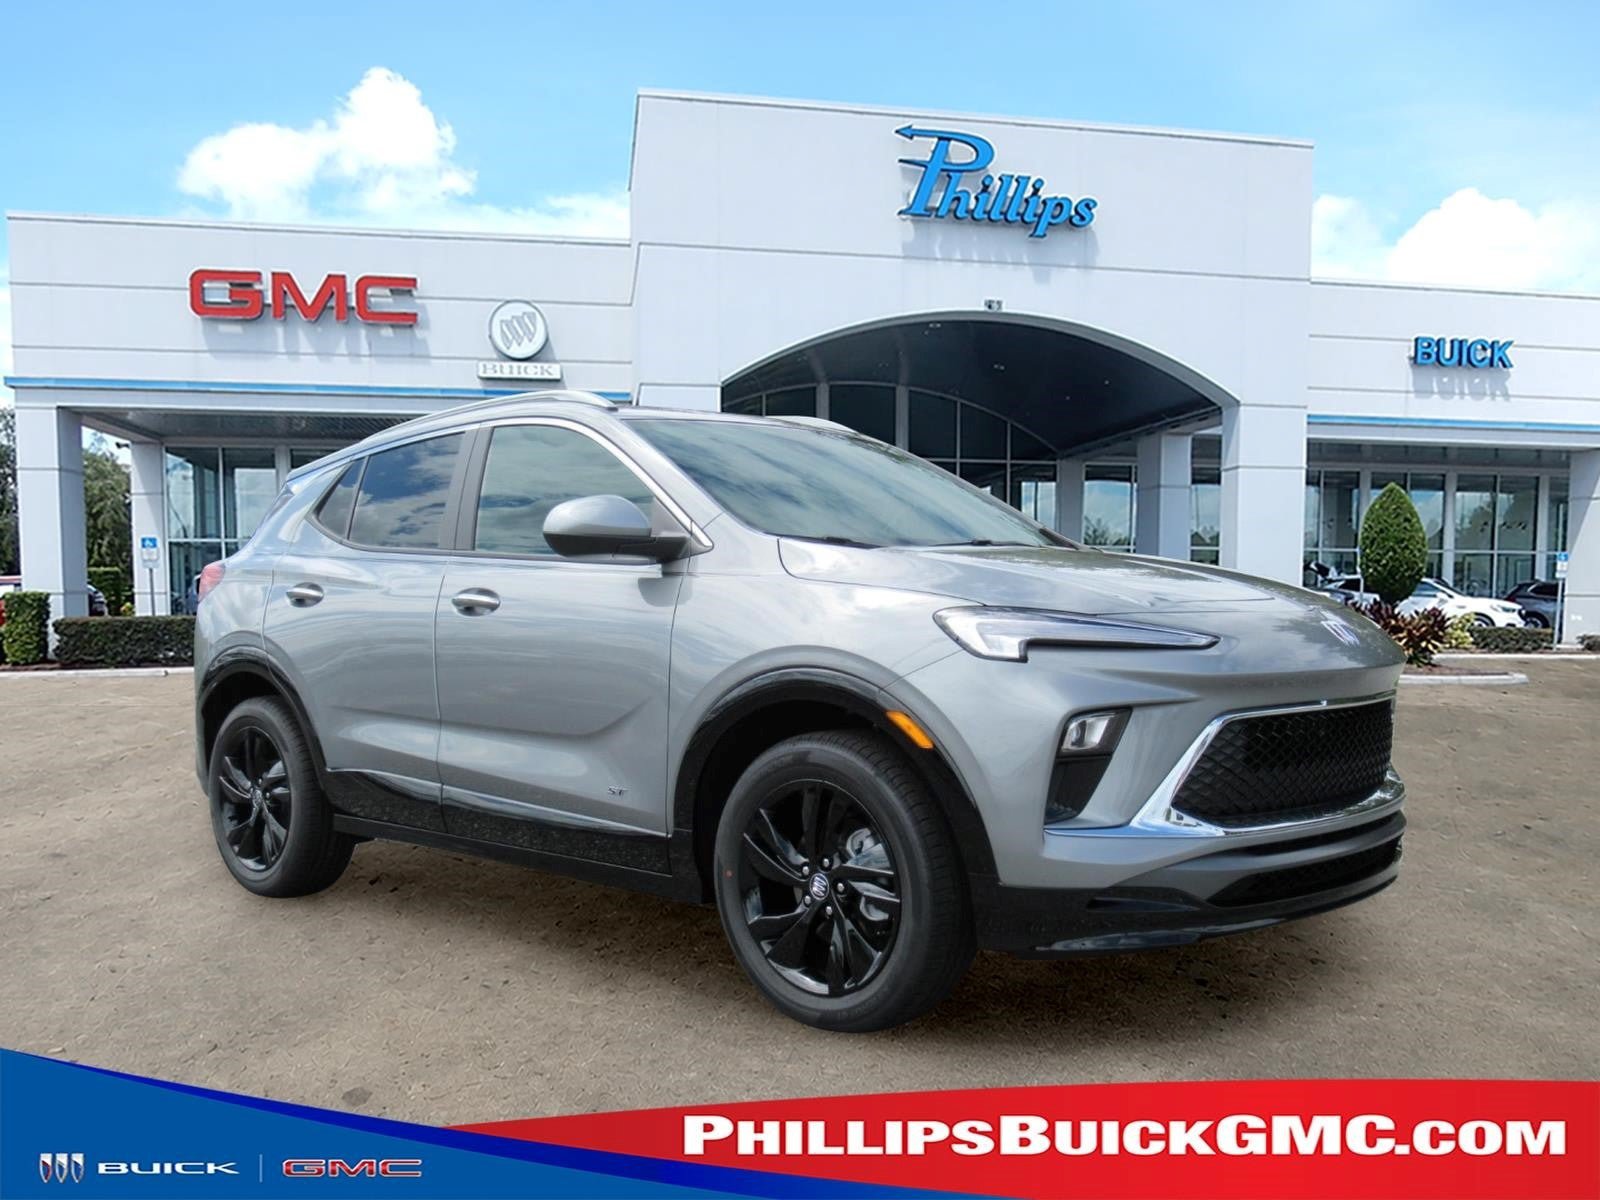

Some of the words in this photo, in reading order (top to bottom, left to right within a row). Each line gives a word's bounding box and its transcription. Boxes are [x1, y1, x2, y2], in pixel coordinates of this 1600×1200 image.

[895, 125, 1098, 238] Phillips
[189, 269, 418, 326] GMC
[481, 362, 555, 377] BUICK
[1414, 336, 1513, 368] BUICK
